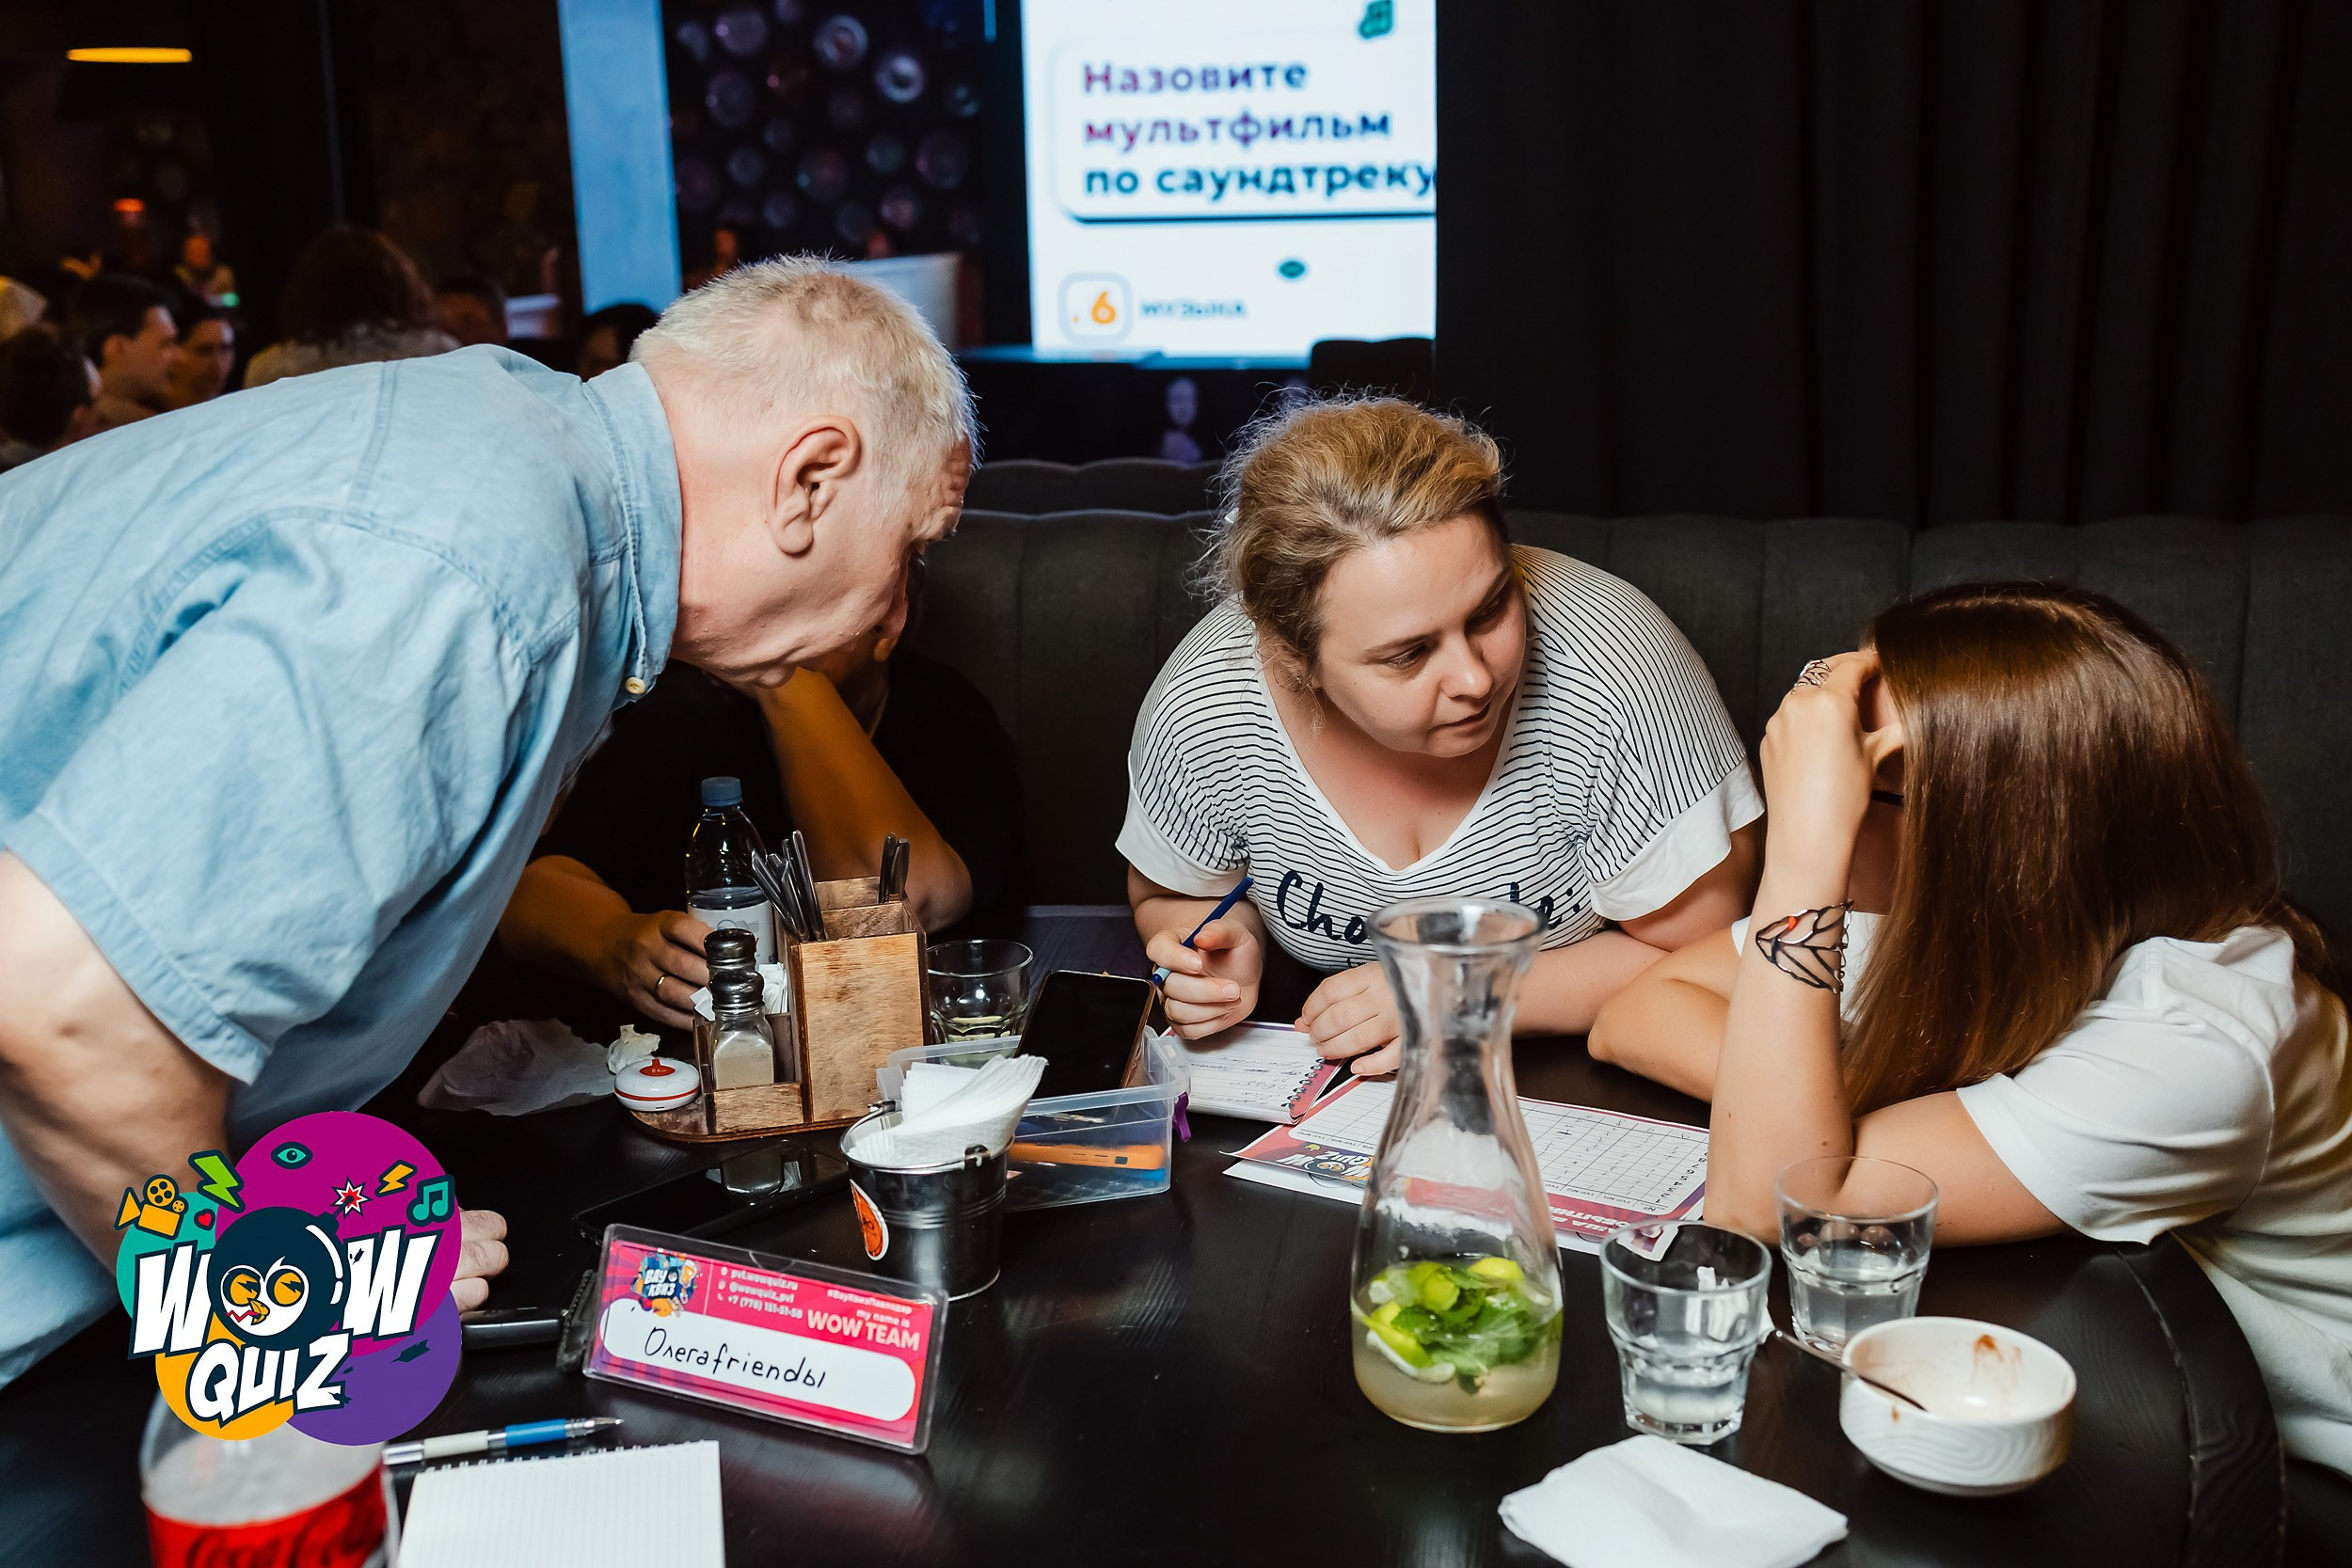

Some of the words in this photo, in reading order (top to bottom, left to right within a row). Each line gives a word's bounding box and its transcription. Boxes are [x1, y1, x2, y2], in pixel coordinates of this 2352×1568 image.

[1084, 62, 1308, 93] Назовите
[1084, 110, 1391, 152] мультфильм
[1085, 168, 1139, 195] по
[1155, 164, 1436, 202] саундтреку
[1315, 1150, 1370, 1165] QUIZ
[644, 1269, 668, 1285] ВАУ
[648, 1283, 676, 1297] КВИЗ
[807, 1309, 864, 1338] WOW
[865, 1322, 920, 1352] TEAM
[856, 1309, 872, 1322] my
[872, 1312, 900, 1326] name
[900, 1318, 911, 1329] is
